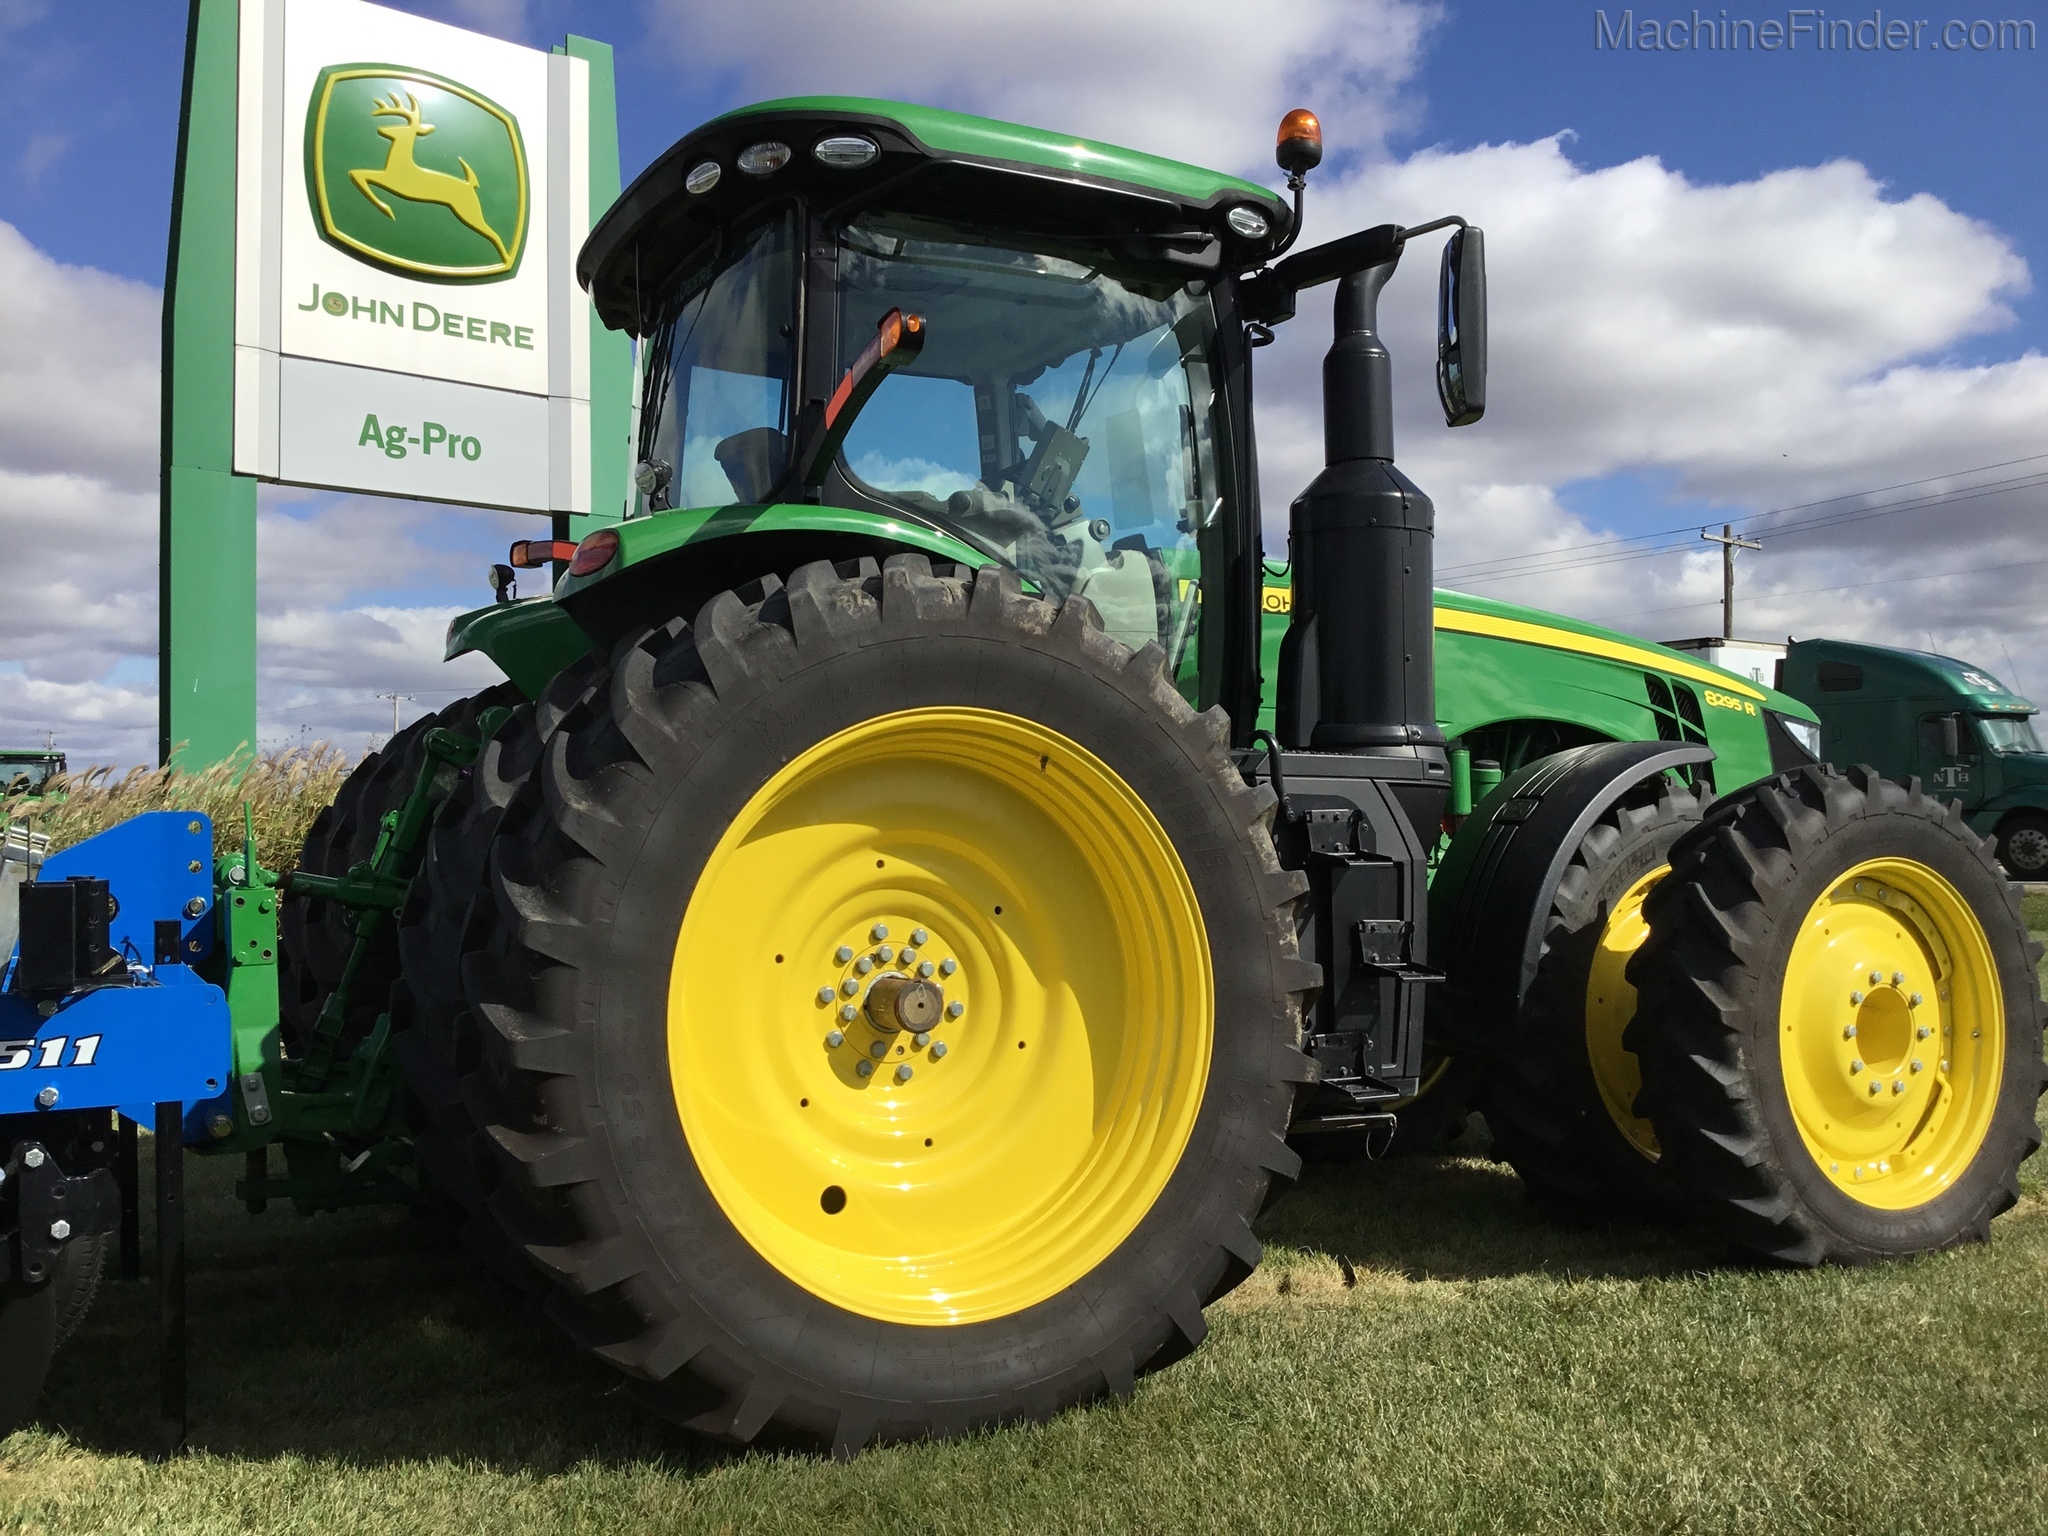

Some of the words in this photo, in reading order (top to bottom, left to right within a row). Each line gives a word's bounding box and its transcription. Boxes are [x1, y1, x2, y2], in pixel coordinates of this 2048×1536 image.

[298, 283, 404, 328] JOHN
[413, 301, 534, 351] DEERE
[358, 413, 481, 461] Ag-Pro
[1262, 594, 1290, 610] OH
[1704, 690, 1742, 711] 8295
[1744, 701, 1756, 717] R
[1933, 766, 1969, 787] NTB
